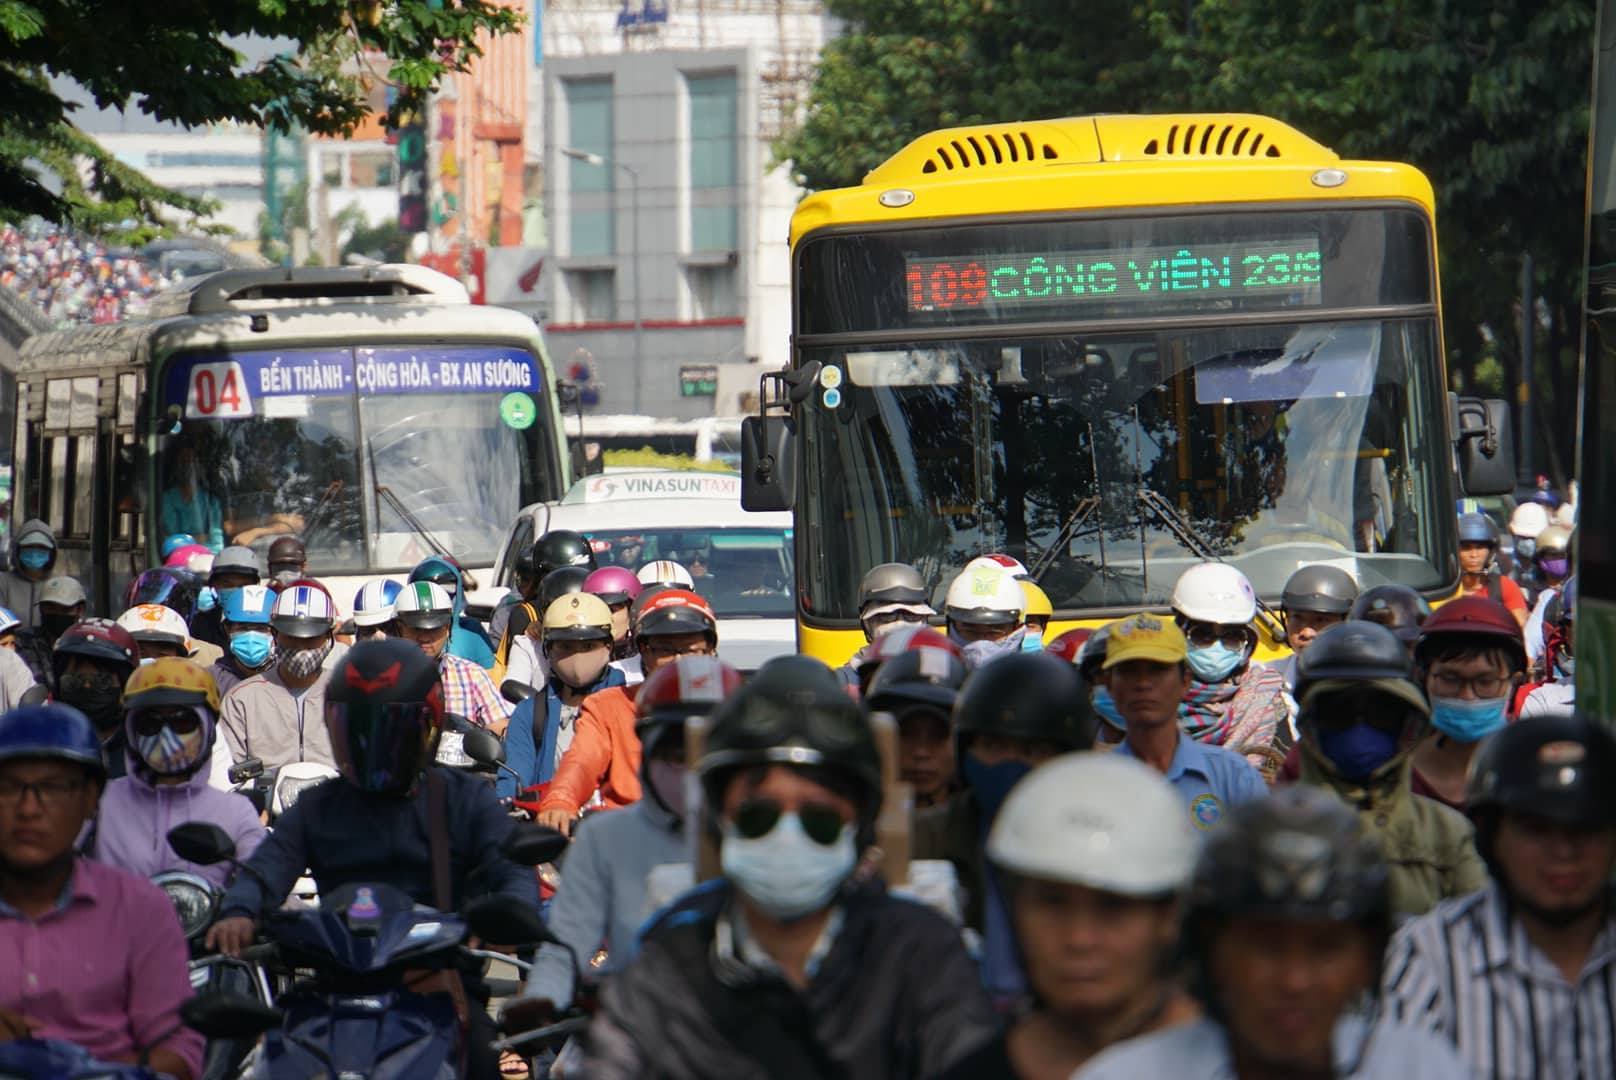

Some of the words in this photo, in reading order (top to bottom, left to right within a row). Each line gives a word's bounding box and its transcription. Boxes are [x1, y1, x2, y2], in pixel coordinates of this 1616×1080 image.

[906, 262, 987, 306] 109
[991, 256, 1119, 297] CÔNG
[1128, 249, 1231, 292] VIÊN
[194, 367, 241, 415] 04
[260, 356, 292, 393] BẾN
[294, 359, 344, 391] THÀNH
[356, 356, 398, 392] CỘNG
[400, 355, 432, 387] HÒA
[440, 362, 461, 387] BX
[463, 362, 482, 387] AN
[484, 358, 531, 388] SƯƠNG
